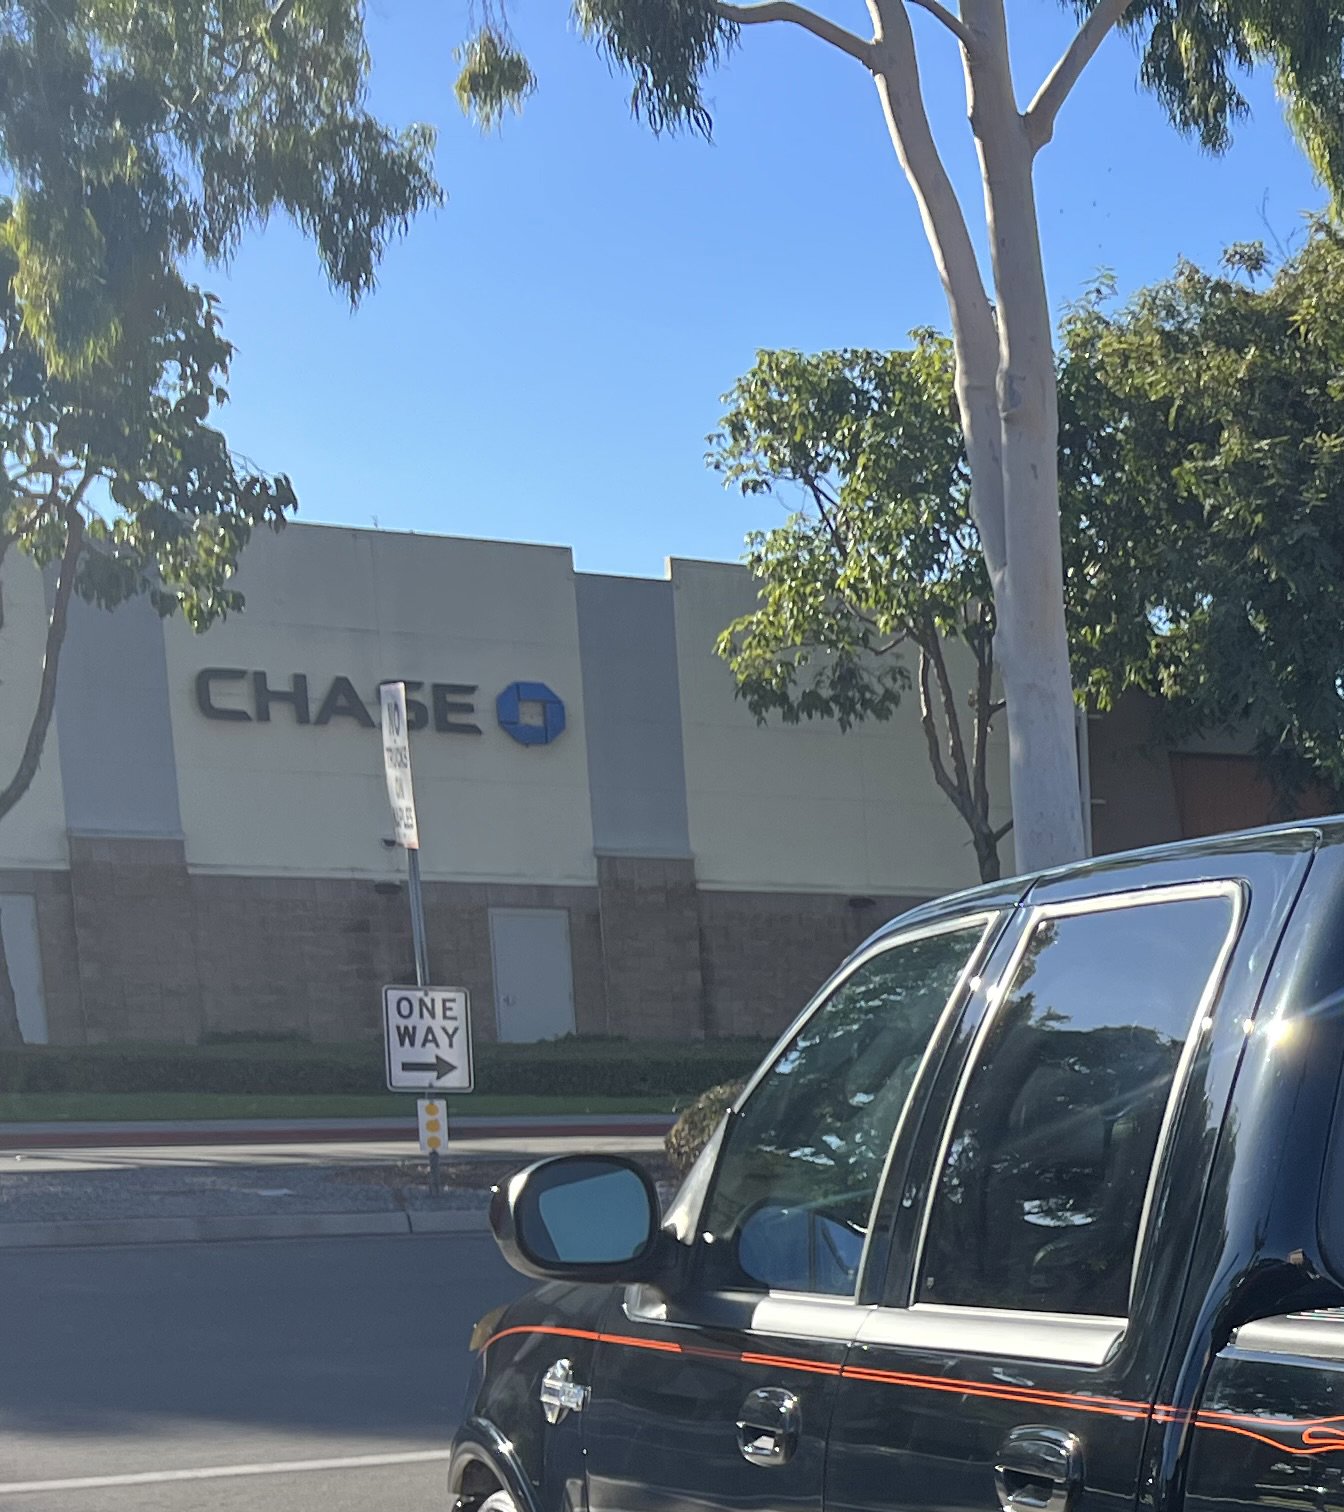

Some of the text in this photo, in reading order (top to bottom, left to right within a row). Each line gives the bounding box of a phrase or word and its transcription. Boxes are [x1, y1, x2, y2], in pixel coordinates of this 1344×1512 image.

[195, 666, 483, 735] CHASE
[395, 996, 458, 1021] ONE
[395, 1025, 459, 1049] WAY
